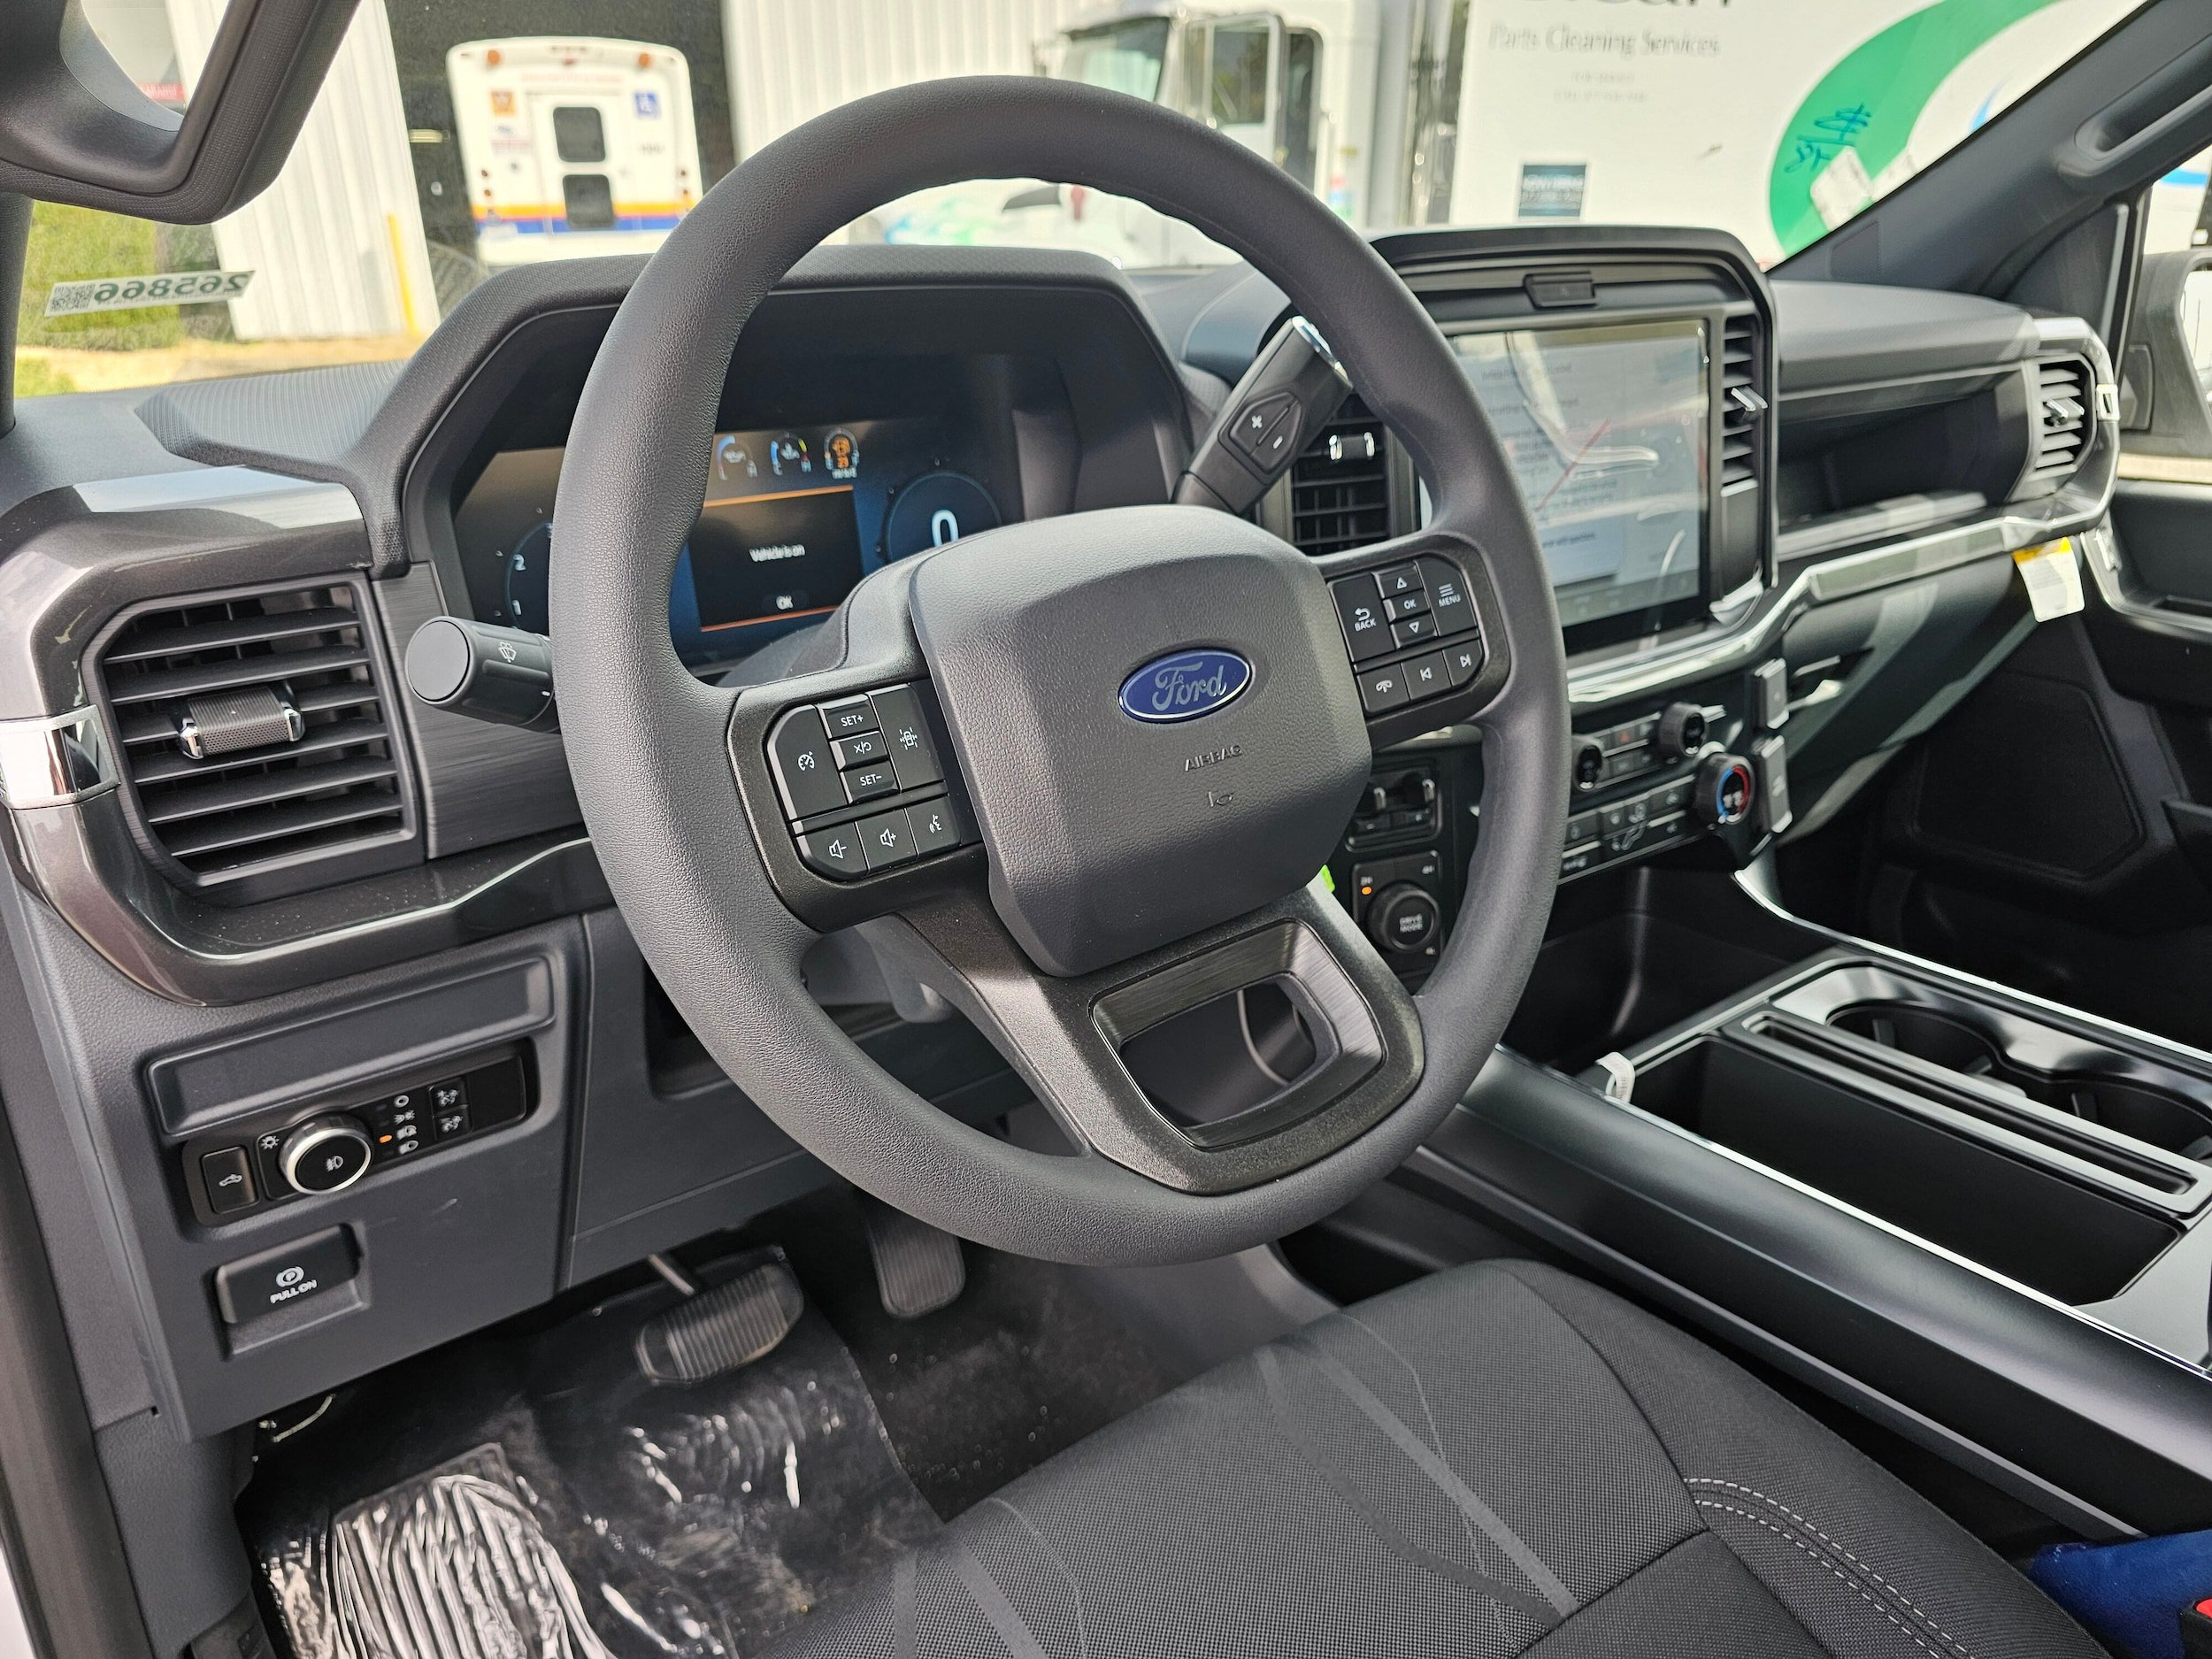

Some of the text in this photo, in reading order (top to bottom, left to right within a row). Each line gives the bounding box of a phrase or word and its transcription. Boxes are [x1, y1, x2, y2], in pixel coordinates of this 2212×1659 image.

[1488, 22, 1721, 59] Parts Cleaning Services
[749, 545, 783, 562] Vehicle
[792, 544, 806, 557] on
[513, 554, 526, 571] 2
[776, 595, 794, 610] OK
[1403, 599, 1417, 610] OK
[1438, 594, 1461, 608] MENU
[1354, 618, 1377, 632] BACK
[1151, 661, 1227, 711] Ford
[1185, 745, 1241, 772] AIRBAG
[270, 1279, 318, 1304] PULL ON
